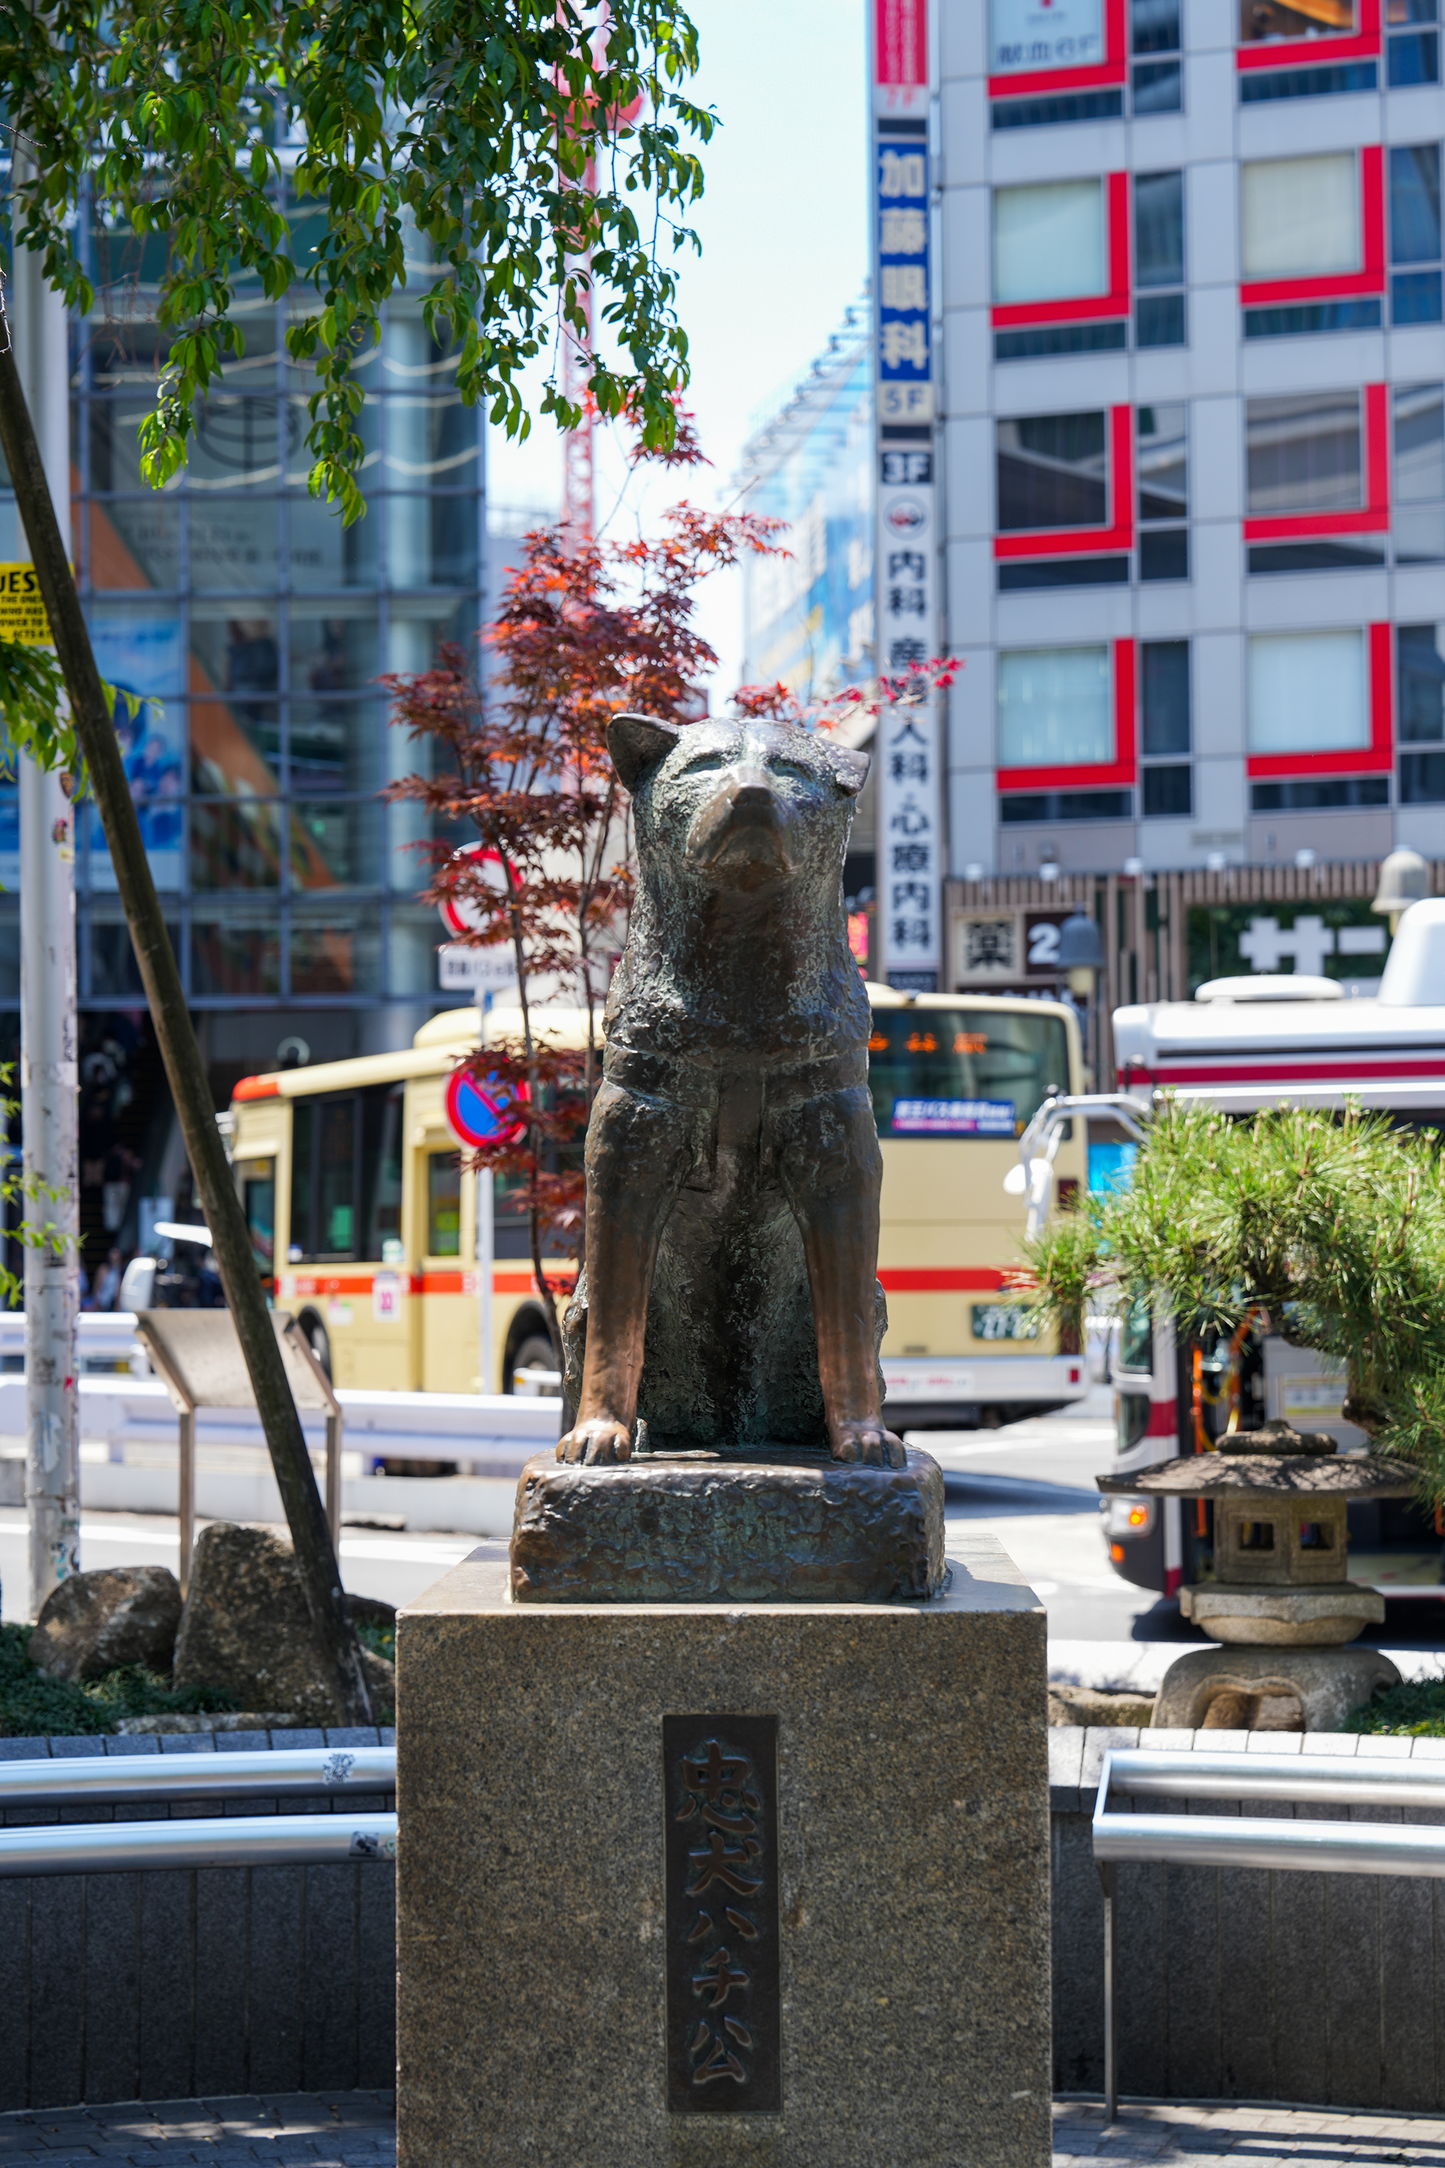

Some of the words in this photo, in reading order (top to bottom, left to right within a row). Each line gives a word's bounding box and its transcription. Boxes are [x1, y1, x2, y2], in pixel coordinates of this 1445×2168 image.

[880, 150, 926, 370] 加藤眼科
[884, 386, 924, 414] 5F
[885, 453, 928, 484] 3F
[887, 550, 926, 621] 内科
[890, 793, 930, 947] 心療内科
[966, 922, 1012, 971] 薬
[676, 1739, 763, 2083] 忠犬ハチ公
